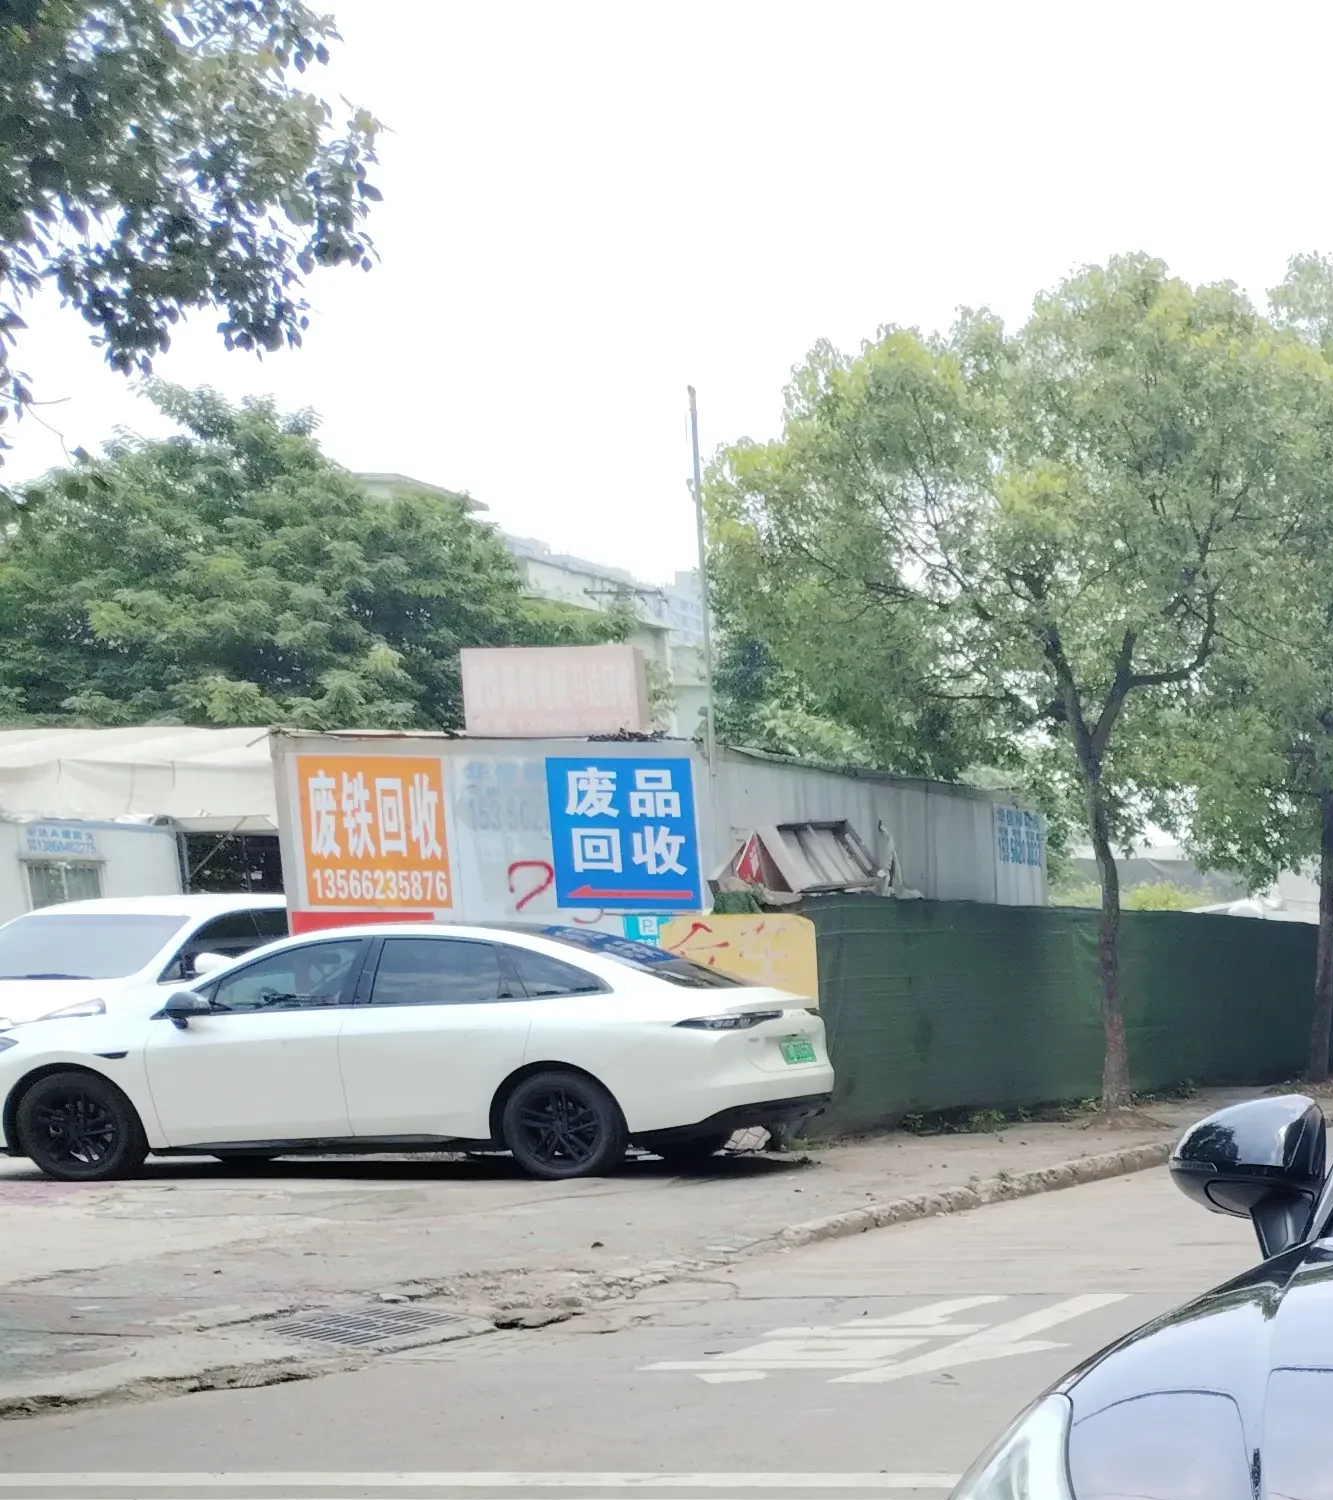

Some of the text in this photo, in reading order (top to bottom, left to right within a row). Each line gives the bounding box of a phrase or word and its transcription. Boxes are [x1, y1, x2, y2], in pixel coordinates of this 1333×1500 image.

[308, 769, 442, 860] 废铁回收
[565, 767, 681, 818] 废品
[572, 826, 688, 875] 回收
[312, 868, 448, 901] 13566235876
